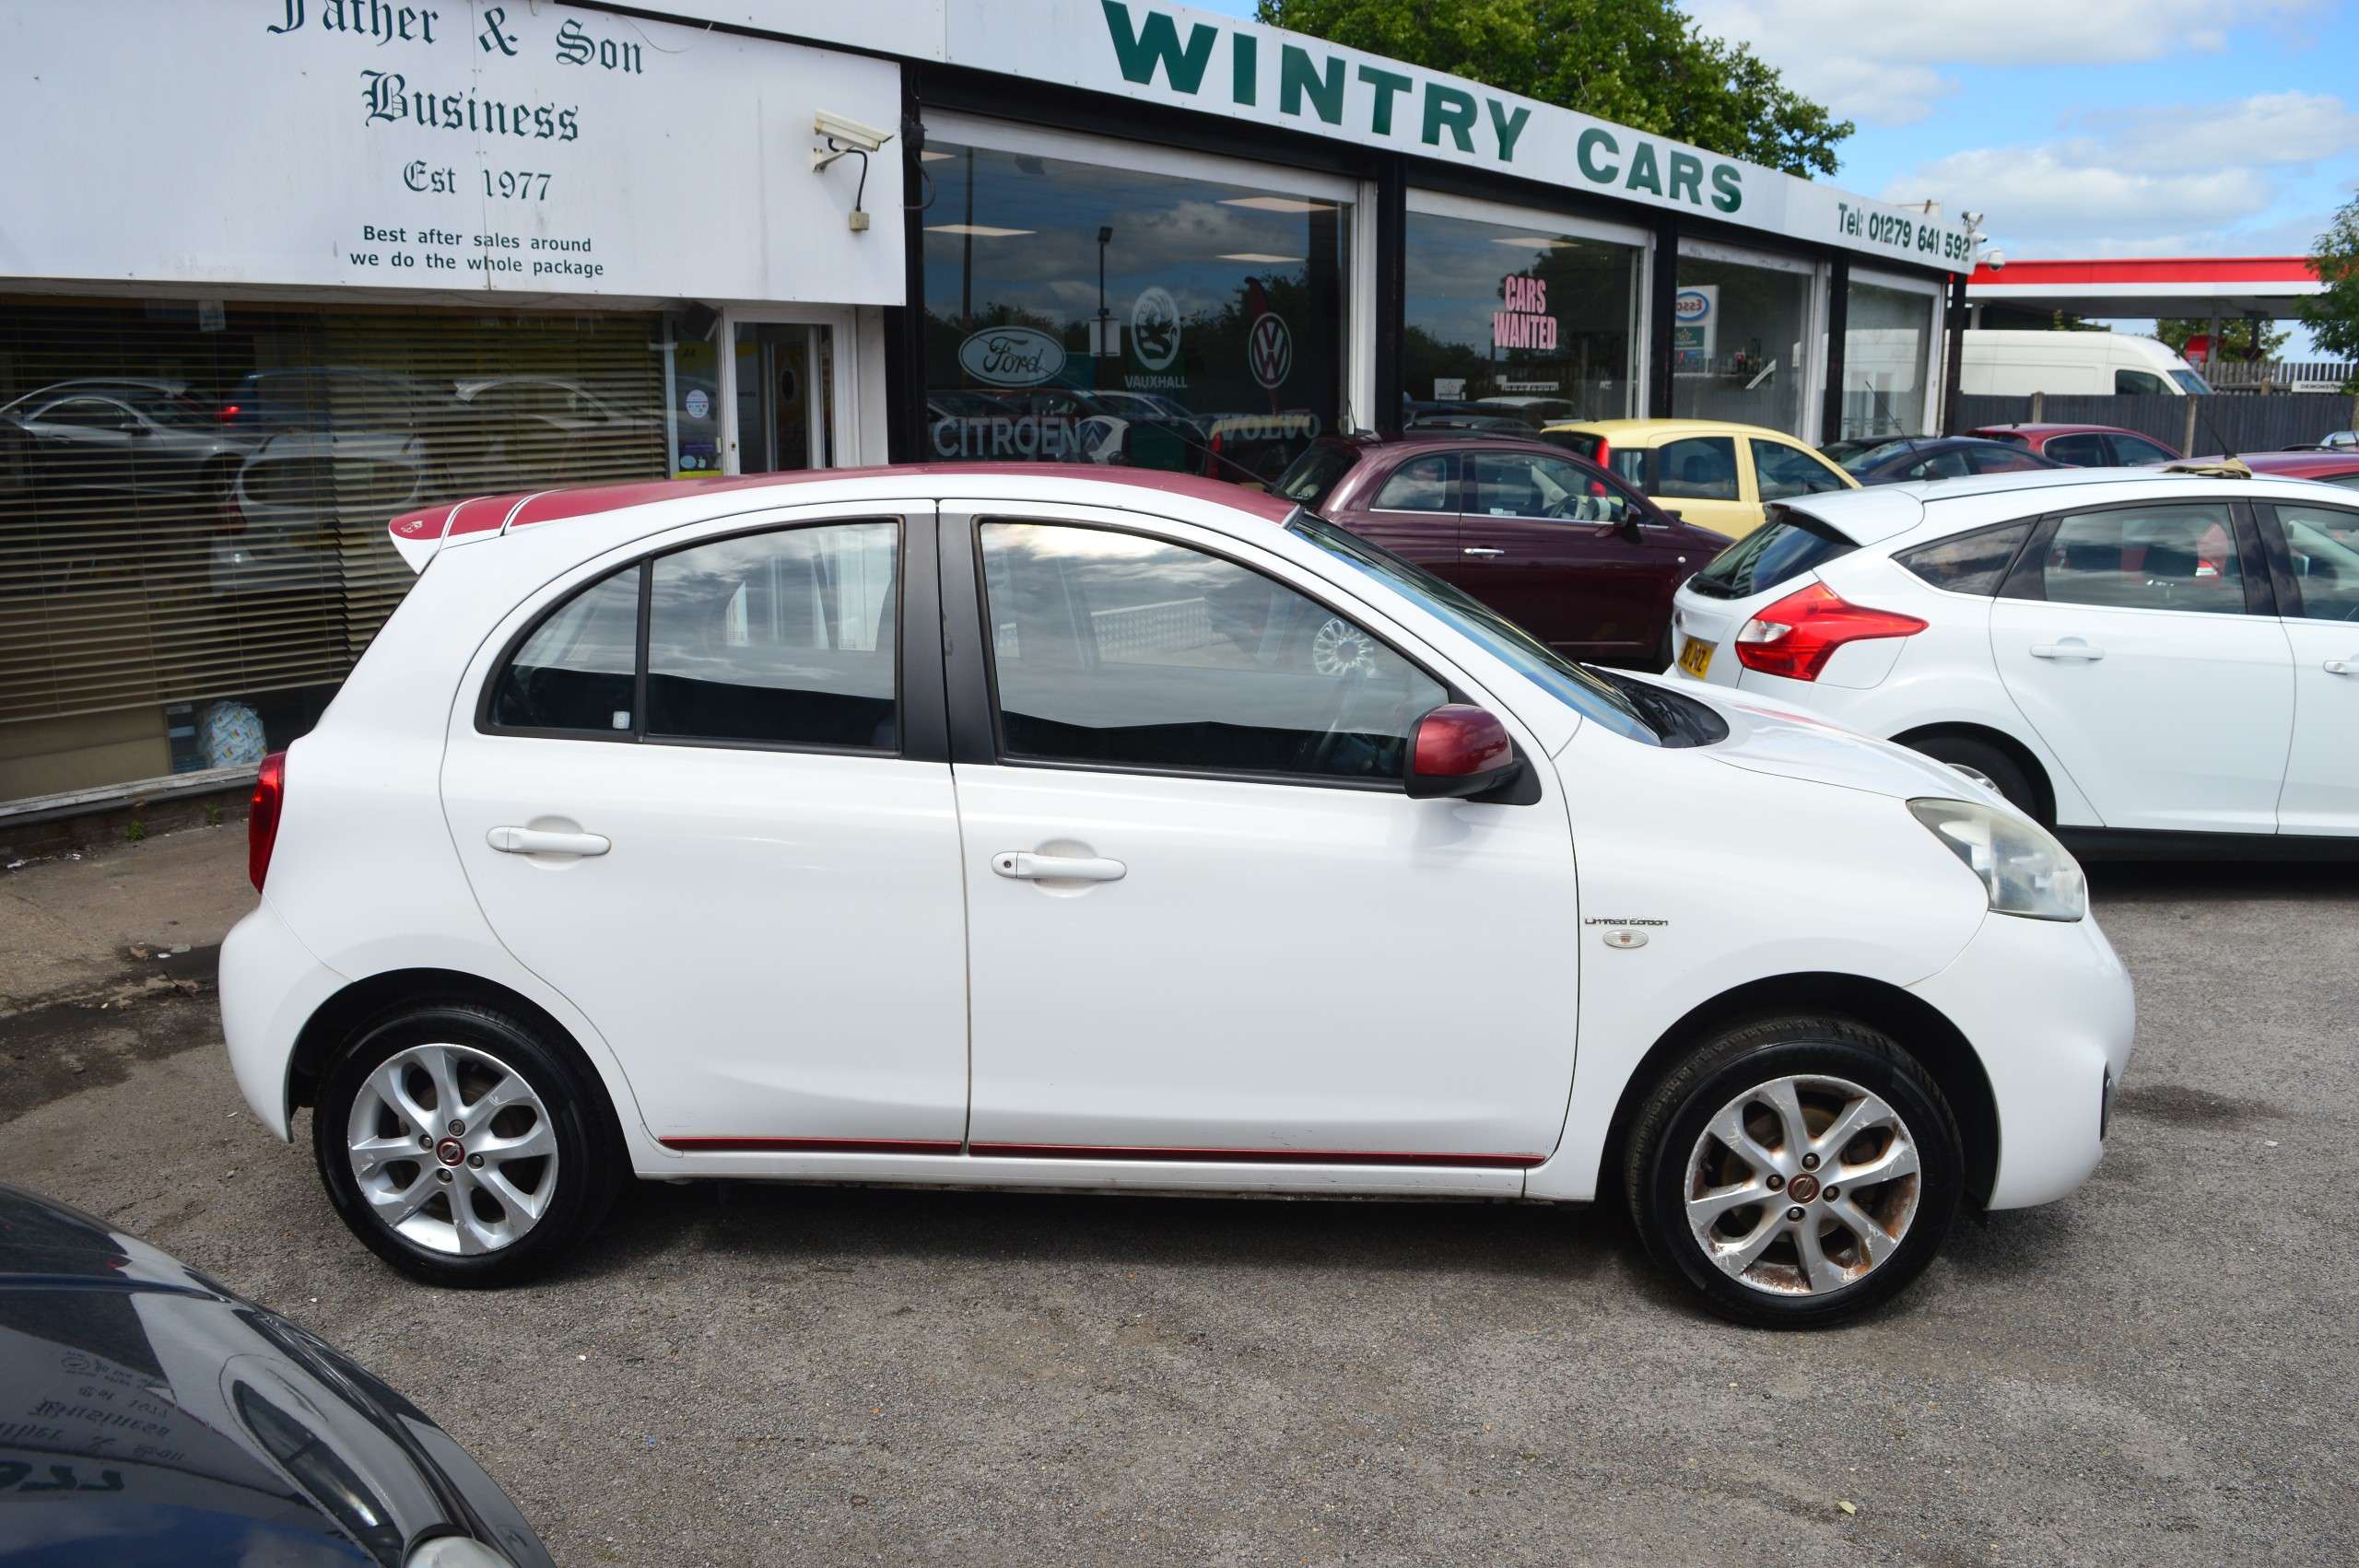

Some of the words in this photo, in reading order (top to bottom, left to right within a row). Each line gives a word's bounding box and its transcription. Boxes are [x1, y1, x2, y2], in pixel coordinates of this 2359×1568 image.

[478, 6, 519, 56] &
[555, 18, 645, 75] Son
[360, 70, 581, 142] Business
[1101, 0, 1532, 163] WINTRY
[1576, 127, 1743, 214] CARS
[403, 159, 456, 194] Est
[483, 169, 552, 201] 1977
[363, 225, 406, 242] Best
[417, 228, 463, 246] after
[473, 231, 521, 249] sales
[531, 237, 592, 252] around
[1838, 202, 1863, 237] Tel:
[1869, 212, 1912, 248] 01279
[1918, 225, 1941, 254] 641
[1944, 232, 1971, 262] 592
[350, 252, 380, 266] we
[391, 252, 415, 267] do
[426, 252, 456, 270] the
[467, 255, 522, 272] whole
[533, 259, 604, 278] package
[1504, 275, 1547, 314] CARS
[1493, 311, 1557, 351] WANTED
[982, 335, 1043, 372] Ford
[1124, 374, 1188, 389] VAUXHALL
[1215, 413, 1320, 440] VOLVO
